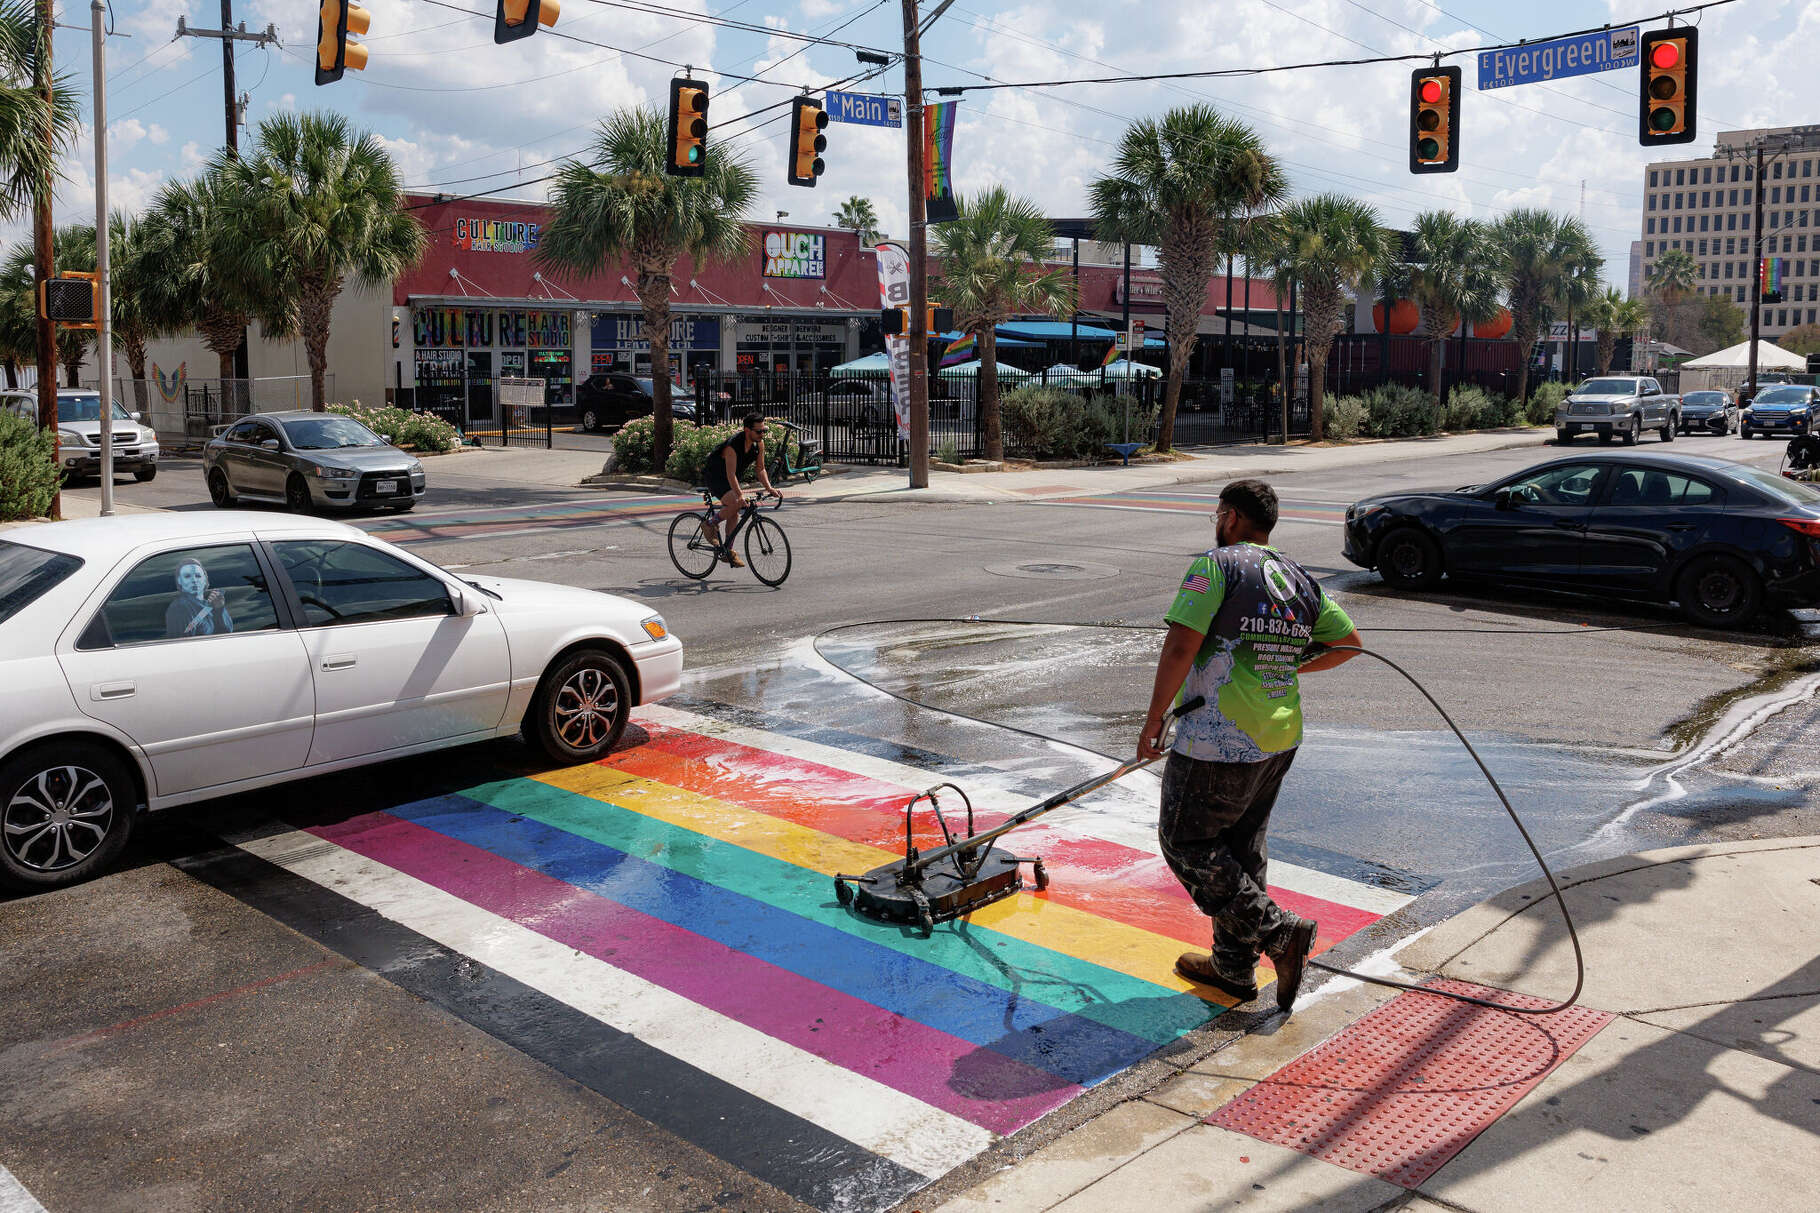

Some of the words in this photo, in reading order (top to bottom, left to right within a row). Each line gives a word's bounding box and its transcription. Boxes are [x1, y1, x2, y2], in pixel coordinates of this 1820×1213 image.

[1483, 54, 1489, 68] E
[1494, 38, 1607, 80] Evergreen
[832, 94, 839, 104] N
[841, 95, 882, 120] Main
[456, 217, 537, 244] CULTURE
[471, 240, 491, 252] HAIR
[494, 241, 525, 253] STUDIO
[766, 233, 823, 260] OUCH
[766, 258, 824, 276] APPAREL
[413, 310, 526, 346] CULTURE
[528, 314, 569, 331] HAIR
[528, 331, 569, 346] STUDIO
[416, 350, 421, 361] A
[421, 350, 438, 360] HAIR
[438, 350, 463, 360] STUDIO
